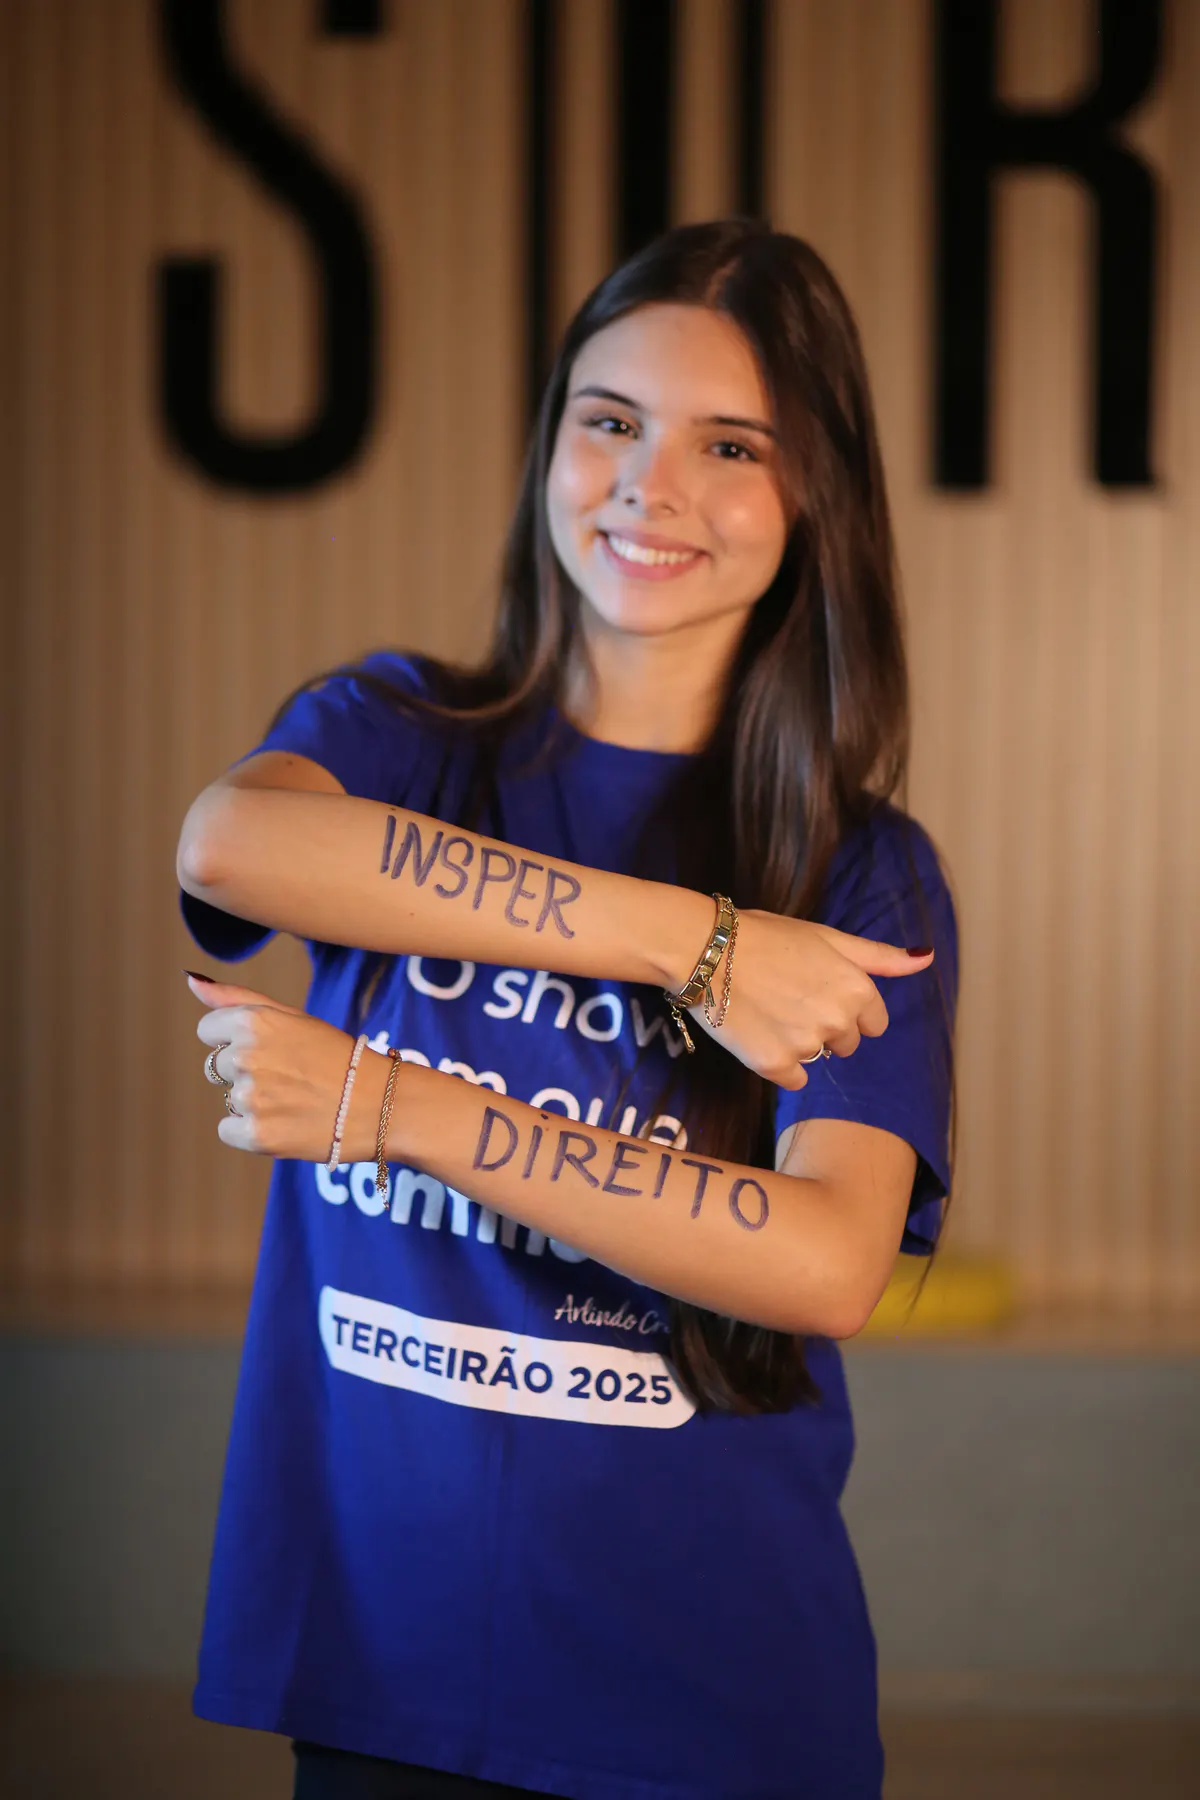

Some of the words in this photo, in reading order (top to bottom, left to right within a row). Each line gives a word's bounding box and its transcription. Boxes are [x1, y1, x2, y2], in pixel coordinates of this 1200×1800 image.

[380, 815, 582, 939] INSPER
[482, 970, 689, 1058] show
[554, 1293, 638, 1331] Arlindo
[332, 1314, 554, 1393] TERCEIRÃO
[567, 1366, 673, 1405] 2025
